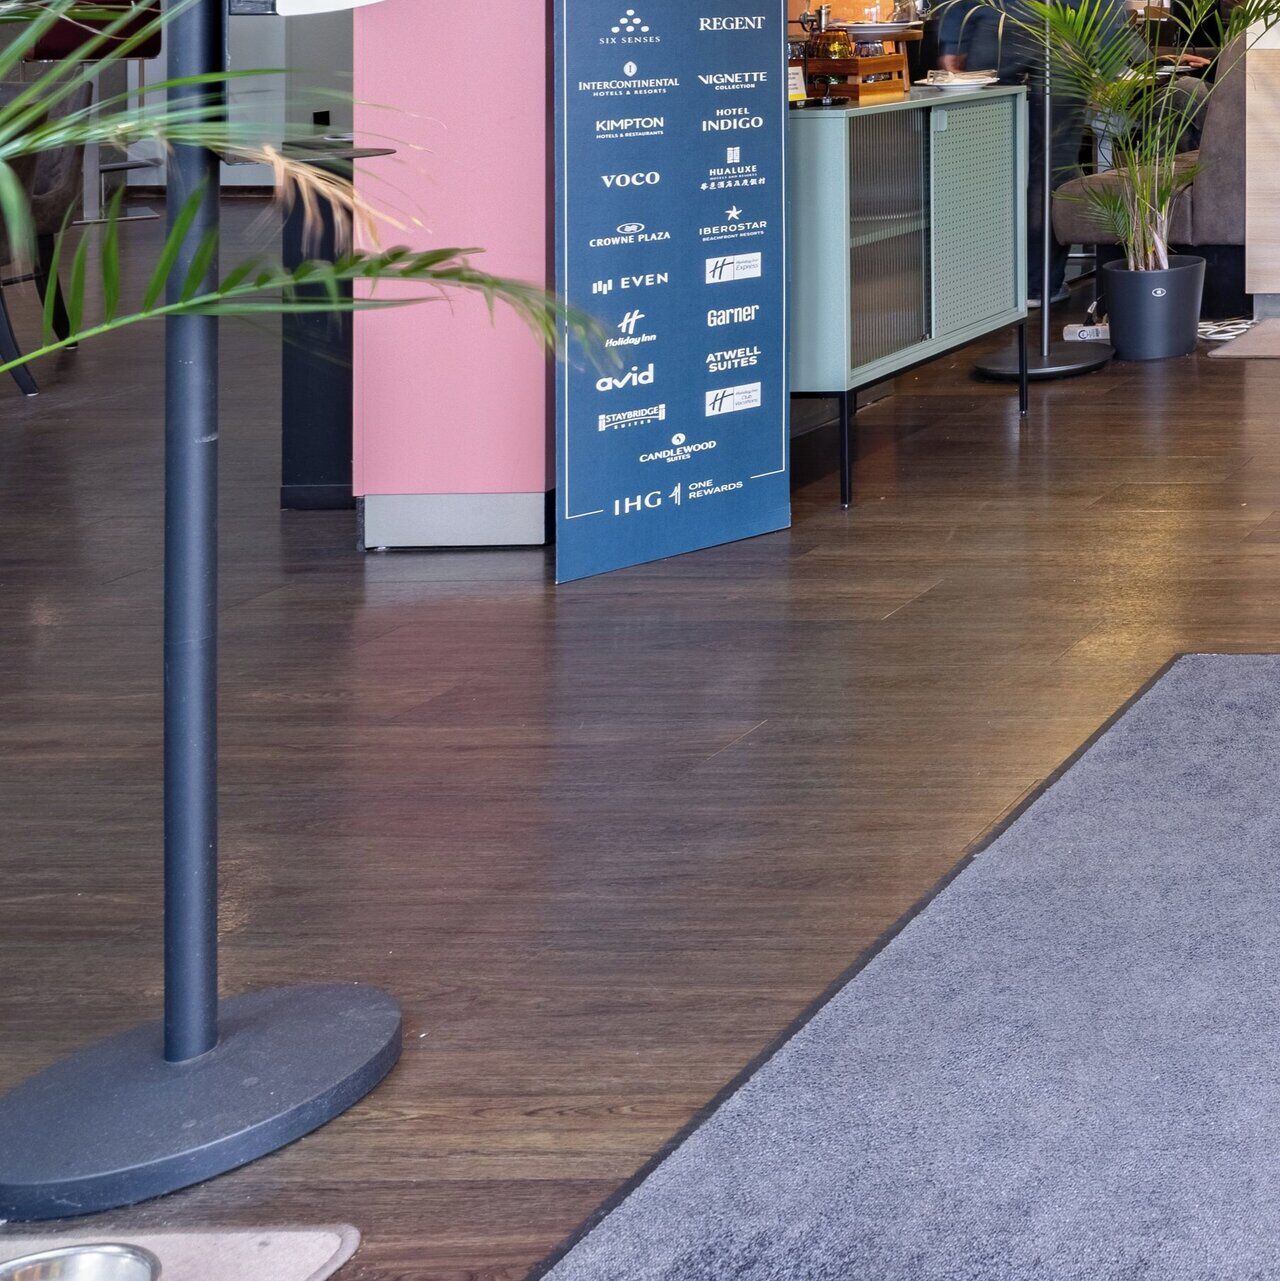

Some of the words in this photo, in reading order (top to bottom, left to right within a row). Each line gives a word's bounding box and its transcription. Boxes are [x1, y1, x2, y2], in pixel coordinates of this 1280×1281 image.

[700, 16, 765, 31] REGENT
[599, 37, 617, 45] SIX
[621, 36, 661, 44] SENSES
[578, 78, 680, 91] INTERCONTINENTAL
[698, 71, 768, 85] VIGNETTE
[716, 107, 750, 116] HOTEL
[596, 116, 664, 132] KIMPTON
[702, 116, 764, 132] INDIGO
[625, 130, 664, 138] RESTAURANTS
[709, 164, 758, 176] HUALUXE
[699, 221, 767, 236] IBEROSTAR
[702, 233, 739, 242] BEACHFRONT
[740, 230, 764, 238] RESORTS
[589, 235, 635, 248] CROWNE
[638, 231, 671, 243] PLAZA
[621, 272, 669, 289] EVEN
[707, 304, 760, 327] Garner
[605, 334, 641, 347] Holiday
[641, 333, 657, 343] Inn
[706, 346, 762, 364] ATWELL
[708, 355, 758, 373] SUITES
[595, 363, 655, 392] avid
[605, 406, 659, 423] STAYBRIDGE
[614, 419, 651, 430] SUITES
[638, 440, 717, 463] CANDLEWOOD
[666, 453, 691, 463] SUITES
[688, 479, 714, 491] ONE
[688, 481, 743, 500] REWARDS
[614, 491, 662, 516] IHG
